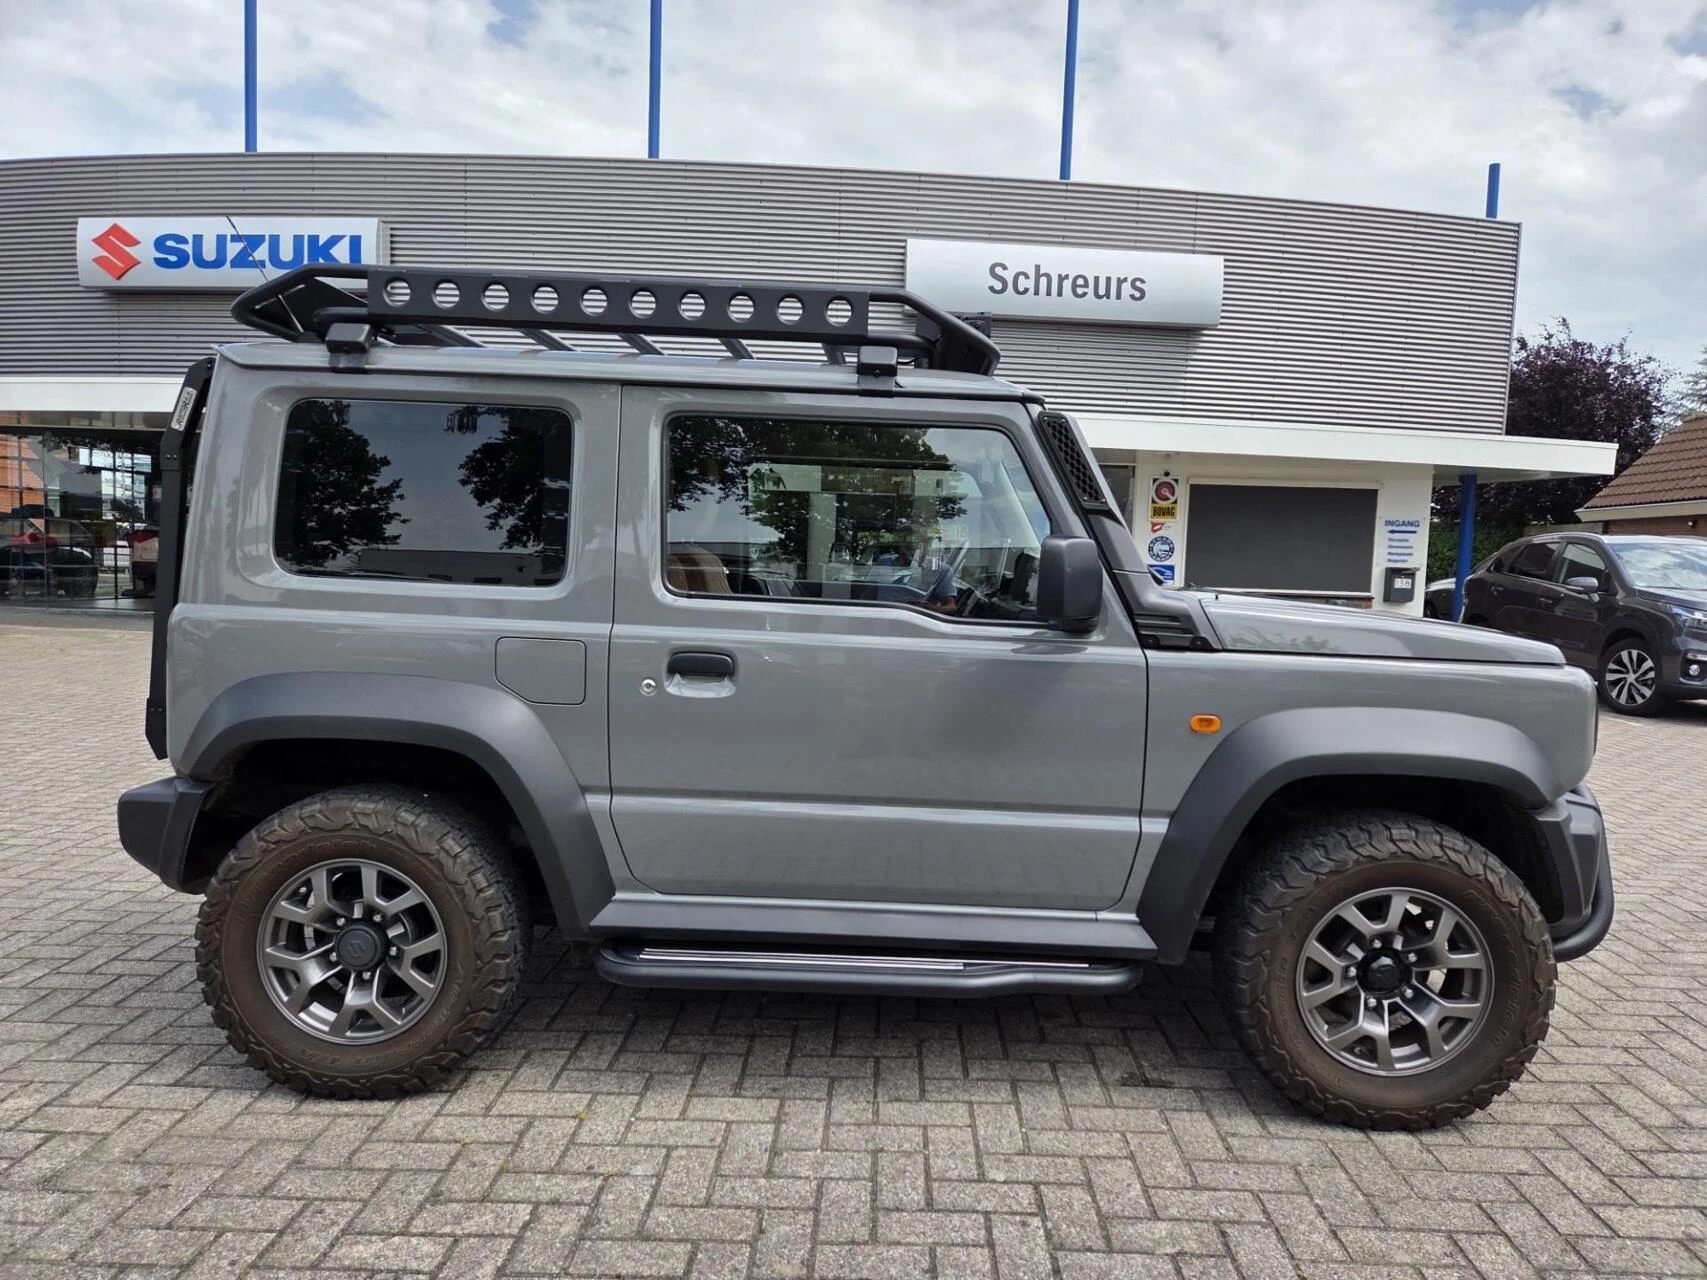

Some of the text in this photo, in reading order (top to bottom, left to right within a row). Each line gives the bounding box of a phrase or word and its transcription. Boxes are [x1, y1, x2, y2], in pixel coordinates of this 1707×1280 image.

[153, 233, 362, 270] SUZUKI
[987, 261, 1147, 302] Schreurs
[1152, 505, 1176, 518] BOVAG
[1384, 519, 1420, 528] INGANG
